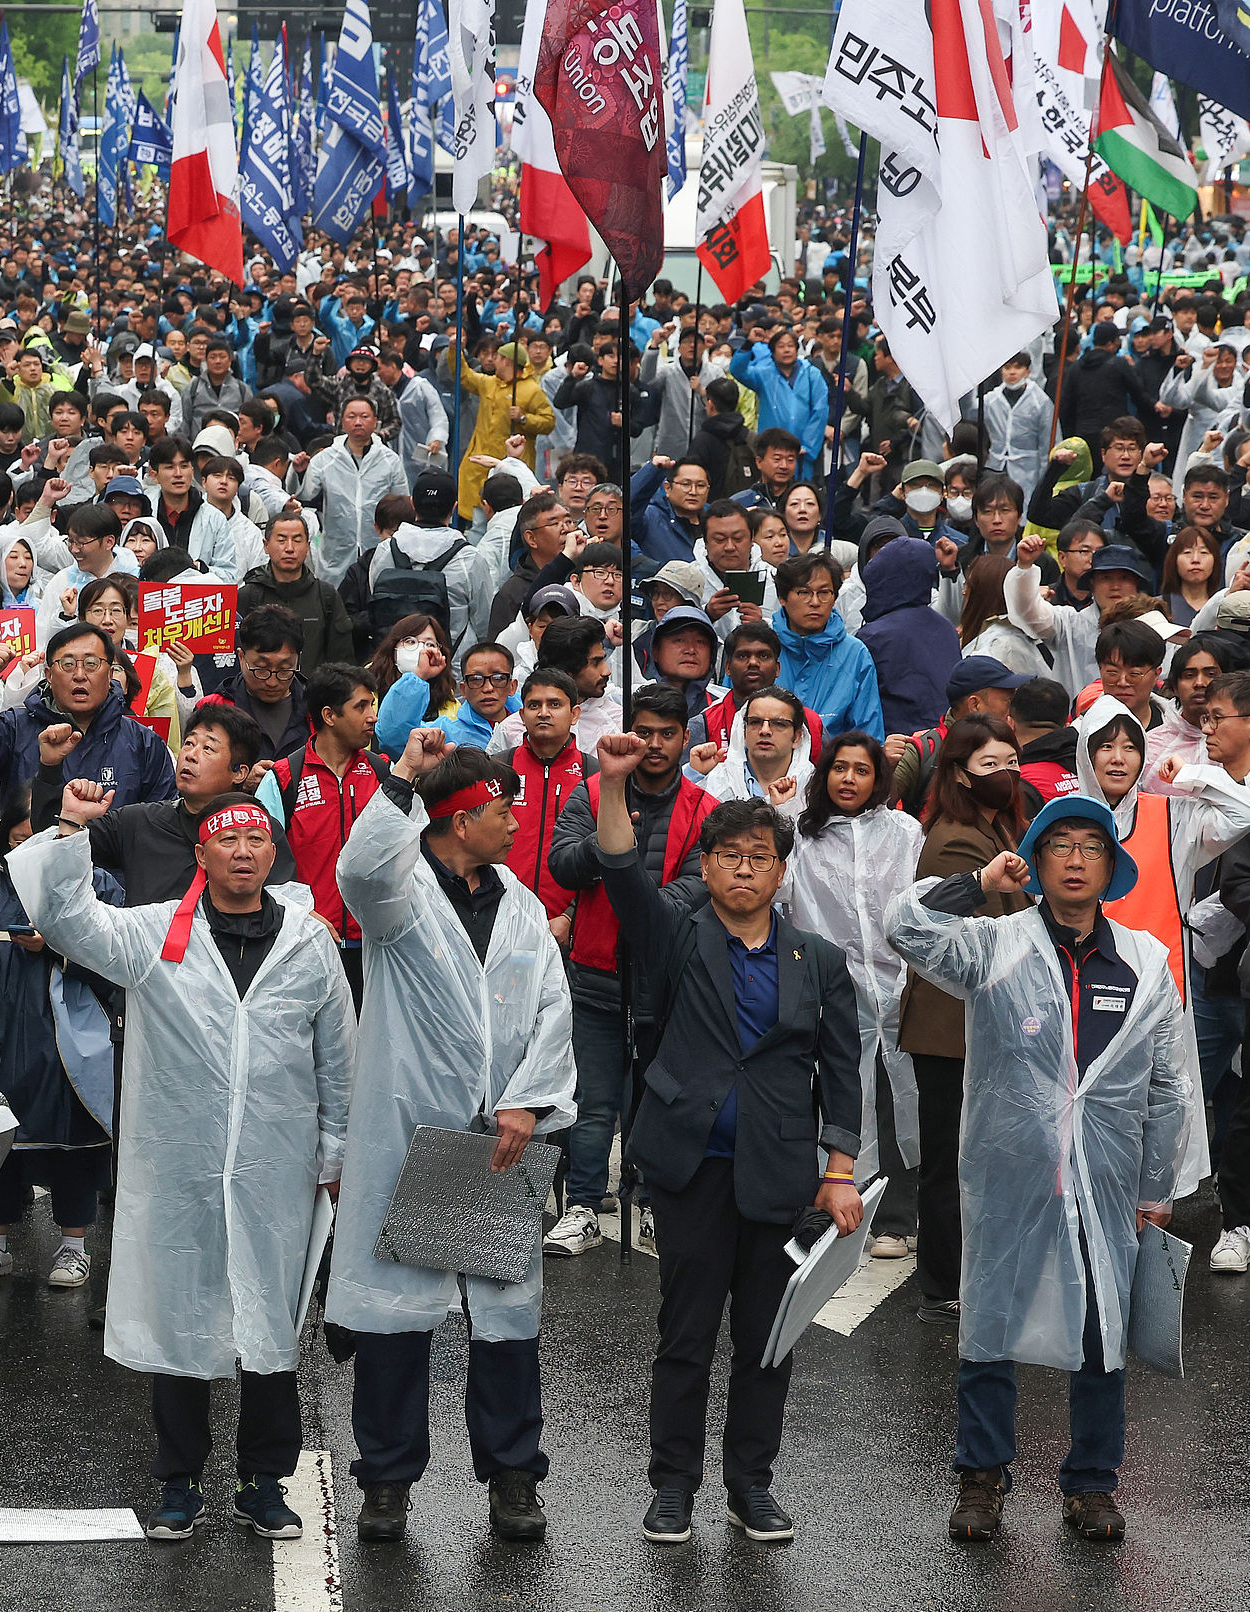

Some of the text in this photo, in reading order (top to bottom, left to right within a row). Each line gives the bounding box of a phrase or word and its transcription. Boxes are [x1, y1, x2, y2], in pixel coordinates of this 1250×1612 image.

[1148, 0, 1250, 60] platfo
[564, 47, 607, 115] Union
[835, 31, 938, 134] 민주노
[327, 86, 387, 148] 전국금
[143, 585, 182, 613] 돌봄
[164, 592, 224, 625] 노동자
[143, 609, 230, 650] 처우개선!
[485, 779, 503, 797] 단
[207, 811, 234, 834] 단결
